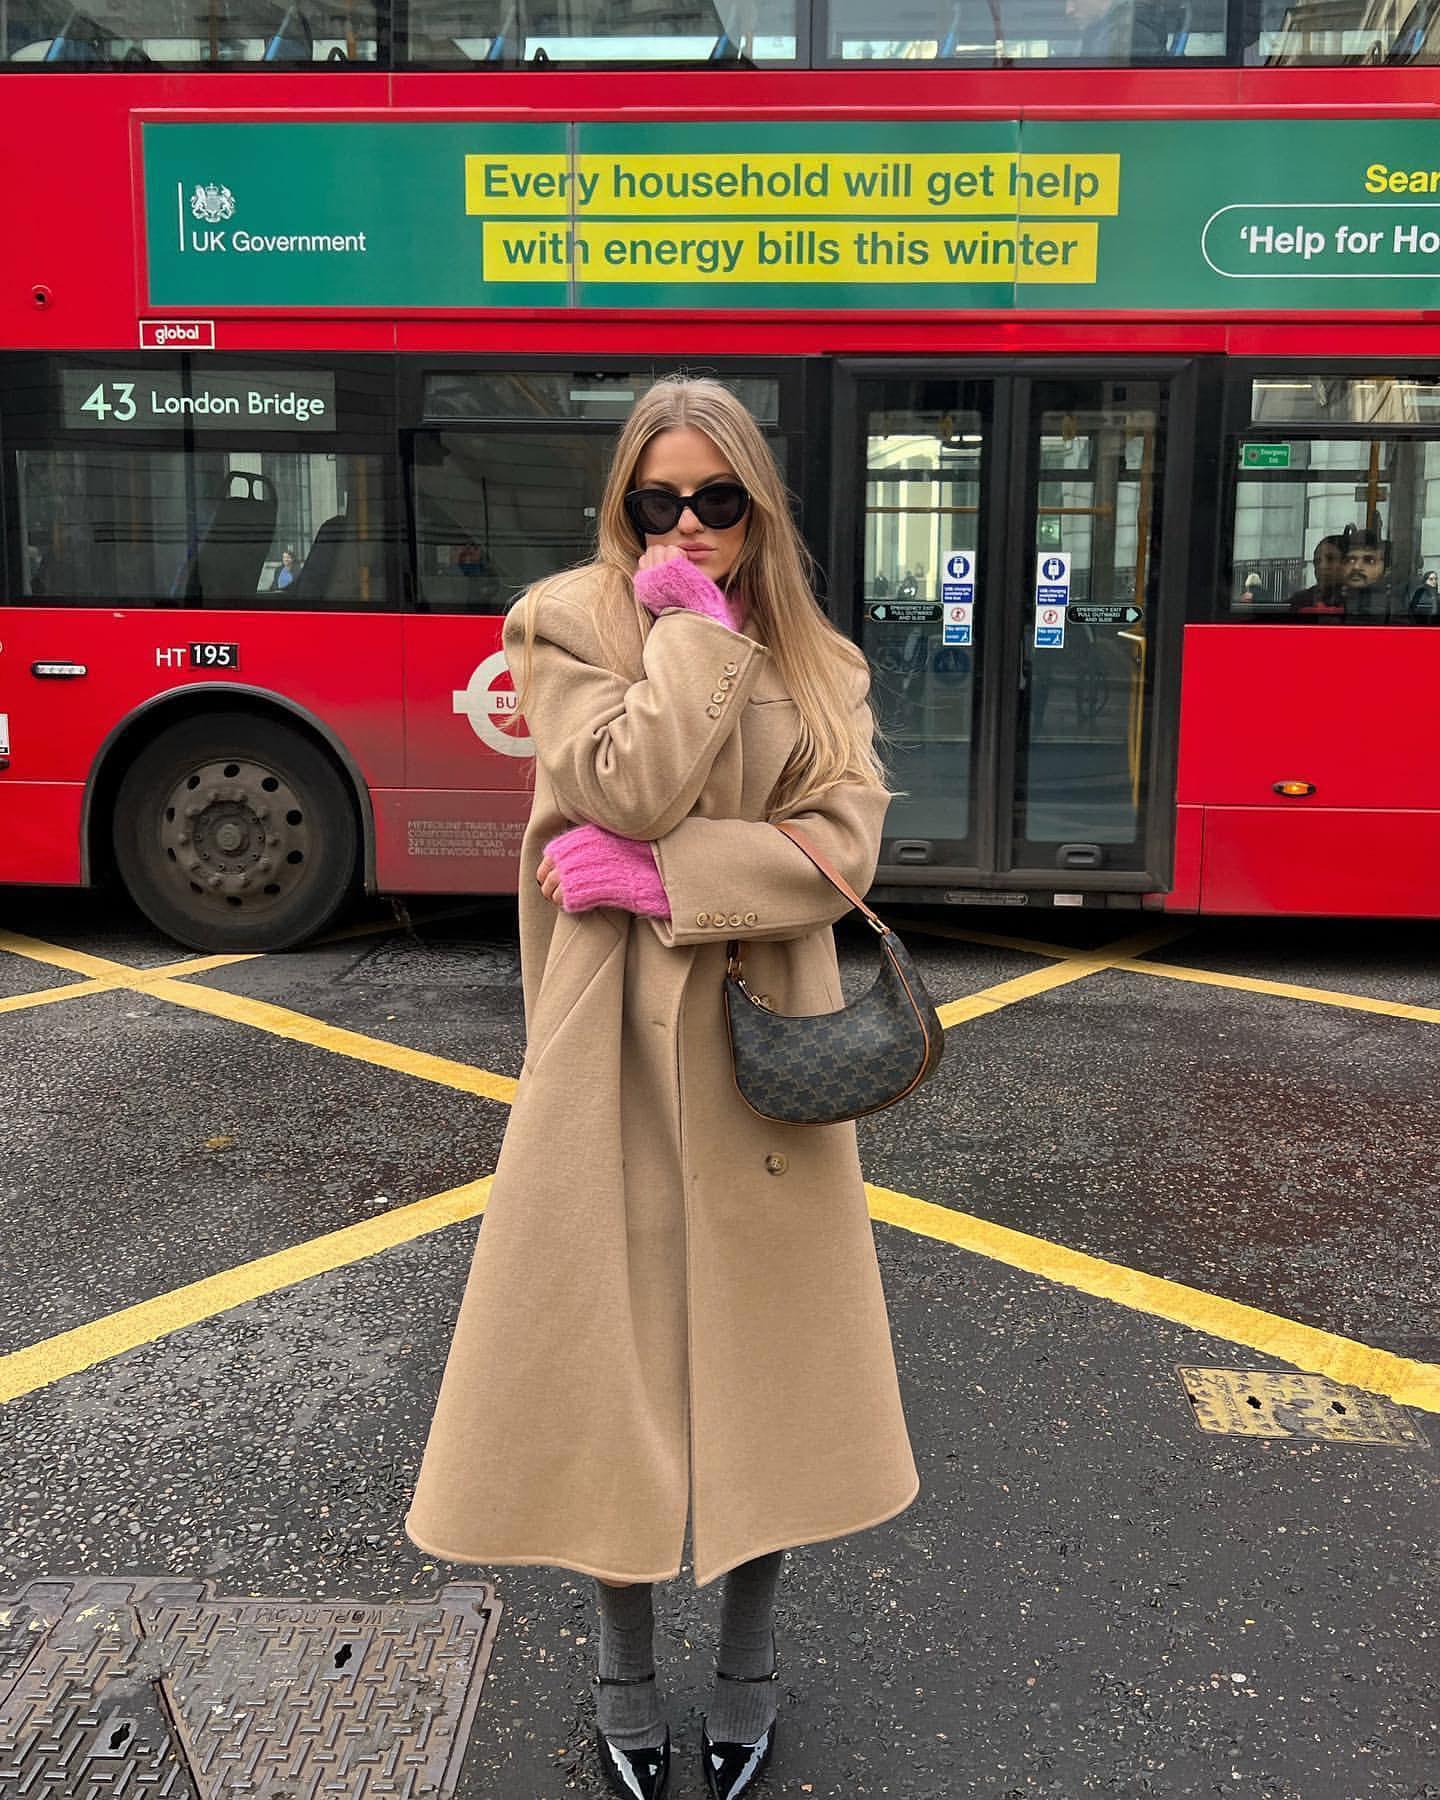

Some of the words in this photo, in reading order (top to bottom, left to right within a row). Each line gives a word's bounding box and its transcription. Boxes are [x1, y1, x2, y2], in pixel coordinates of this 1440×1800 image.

[483, 163, 600, 206] Every
[613, 163, 829, 198] household
[843, 163, 912, 197] will
[927, 164, 995, 206] get
[1008, 163, 1100, 205] help
[1364, 164, 1440, 193] Sear
[192, 231, 226, 252] UK
[232, 231, 367, 252] Government
[502, 231, 590, 265] with
[603, 238, 744, 273] energy
[757, 231, 840, 266] bills
[853, 231, 929, 265] this
[943, 231, 1078, 266] winter
[1334, 225, 1384, 253] for
[1393, 224, 1440, 254] Ho
[154, 324, 200, 345] global
[79, 383, 137, 421] 43
[151, 391, 240, 414] London
[248, 391, 325, 421] Bridge
[156, 647, 187, 668] HT
[193, 644, 231, 665] 195
